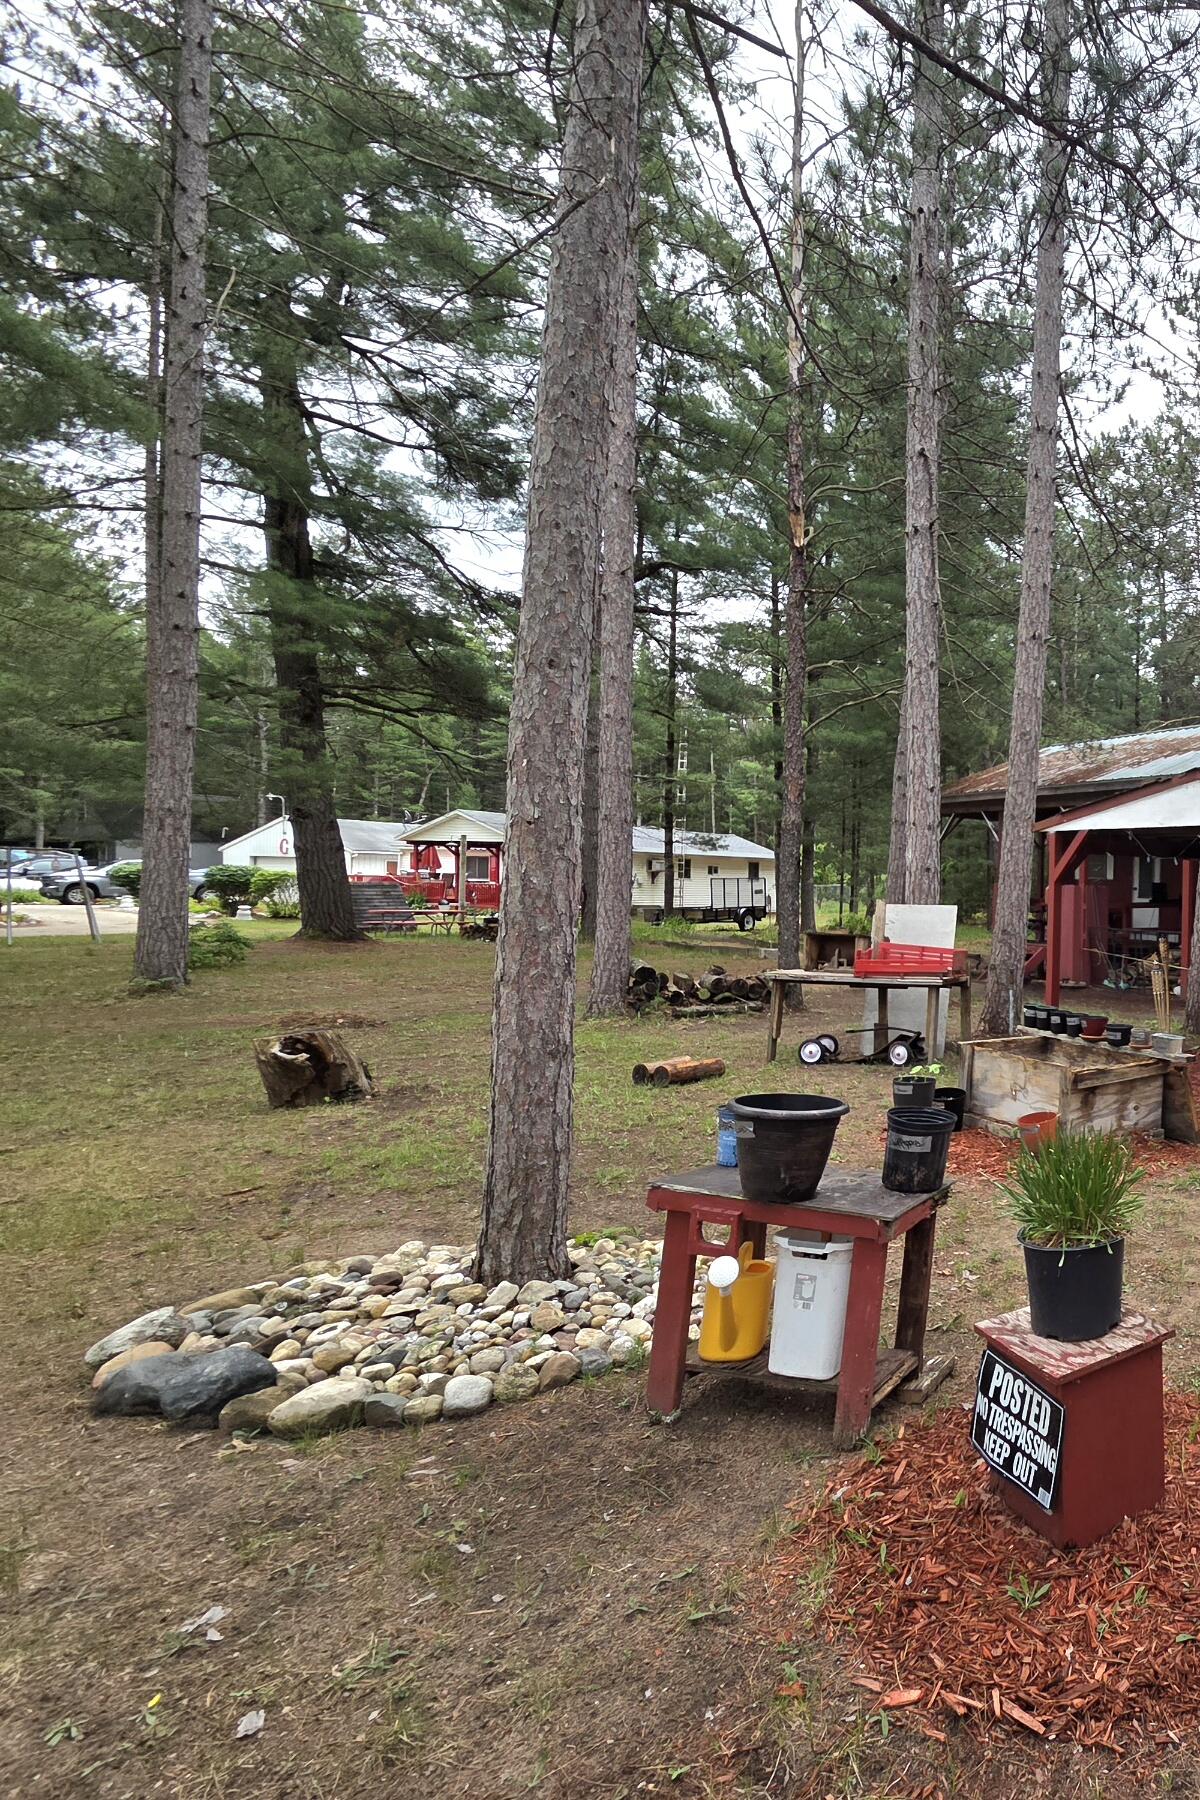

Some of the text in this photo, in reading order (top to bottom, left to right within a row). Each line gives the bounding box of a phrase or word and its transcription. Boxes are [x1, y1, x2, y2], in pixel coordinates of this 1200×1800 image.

[977, 1391, 1058, 1474] NO TRESPASSING
[989, 1363, 1051, 1437] POSTED
[983, 1427, 1038, 1488] KEEP OUT
